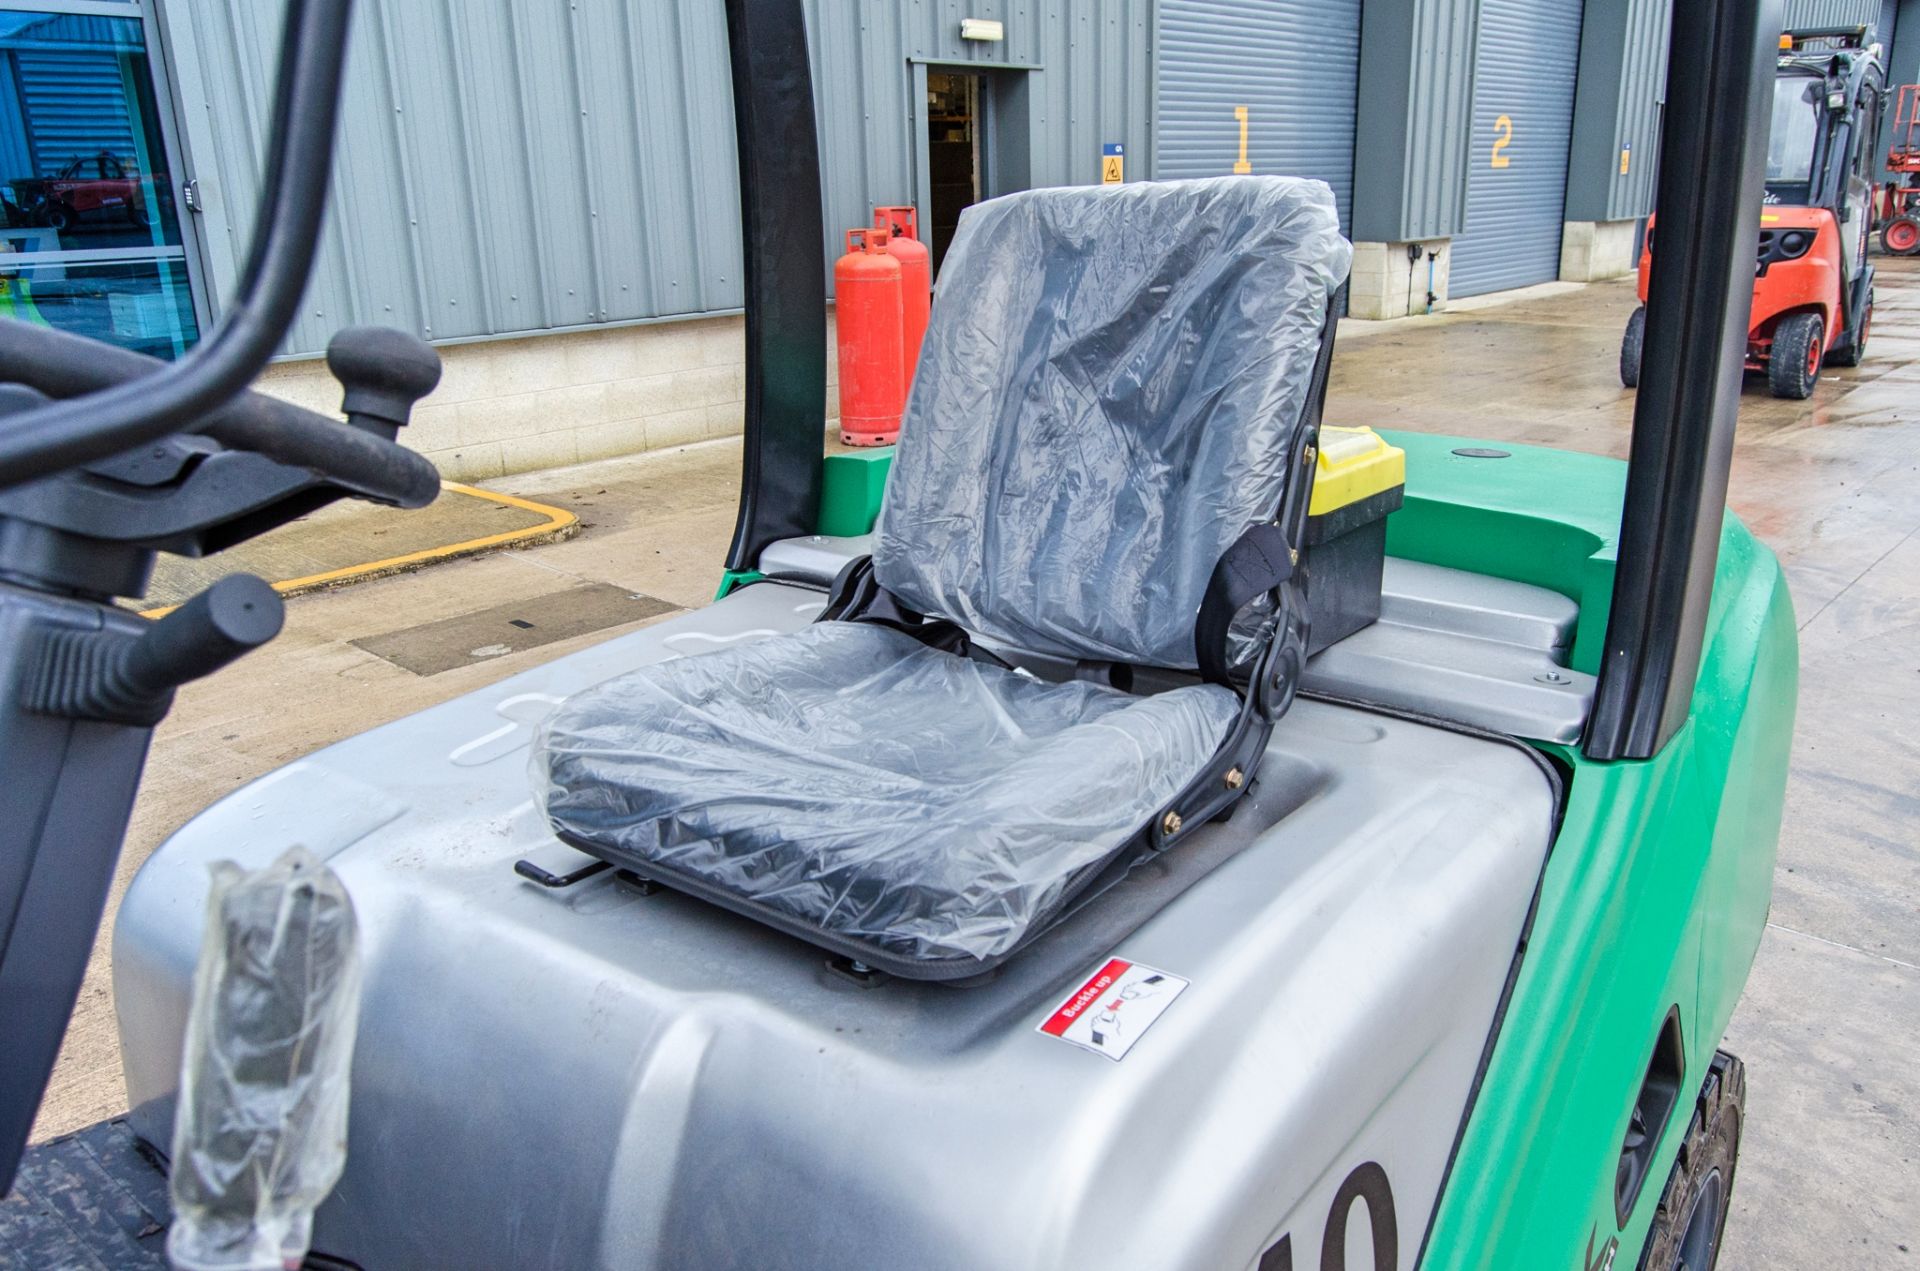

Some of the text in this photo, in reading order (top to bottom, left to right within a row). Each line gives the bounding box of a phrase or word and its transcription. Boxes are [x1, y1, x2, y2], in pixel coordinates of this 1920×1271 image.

[1234, 105, 1252, 174] 1
[1491, 114, 1512, 168] 2
[1061, 975, 1112, 1018] Buckle up
